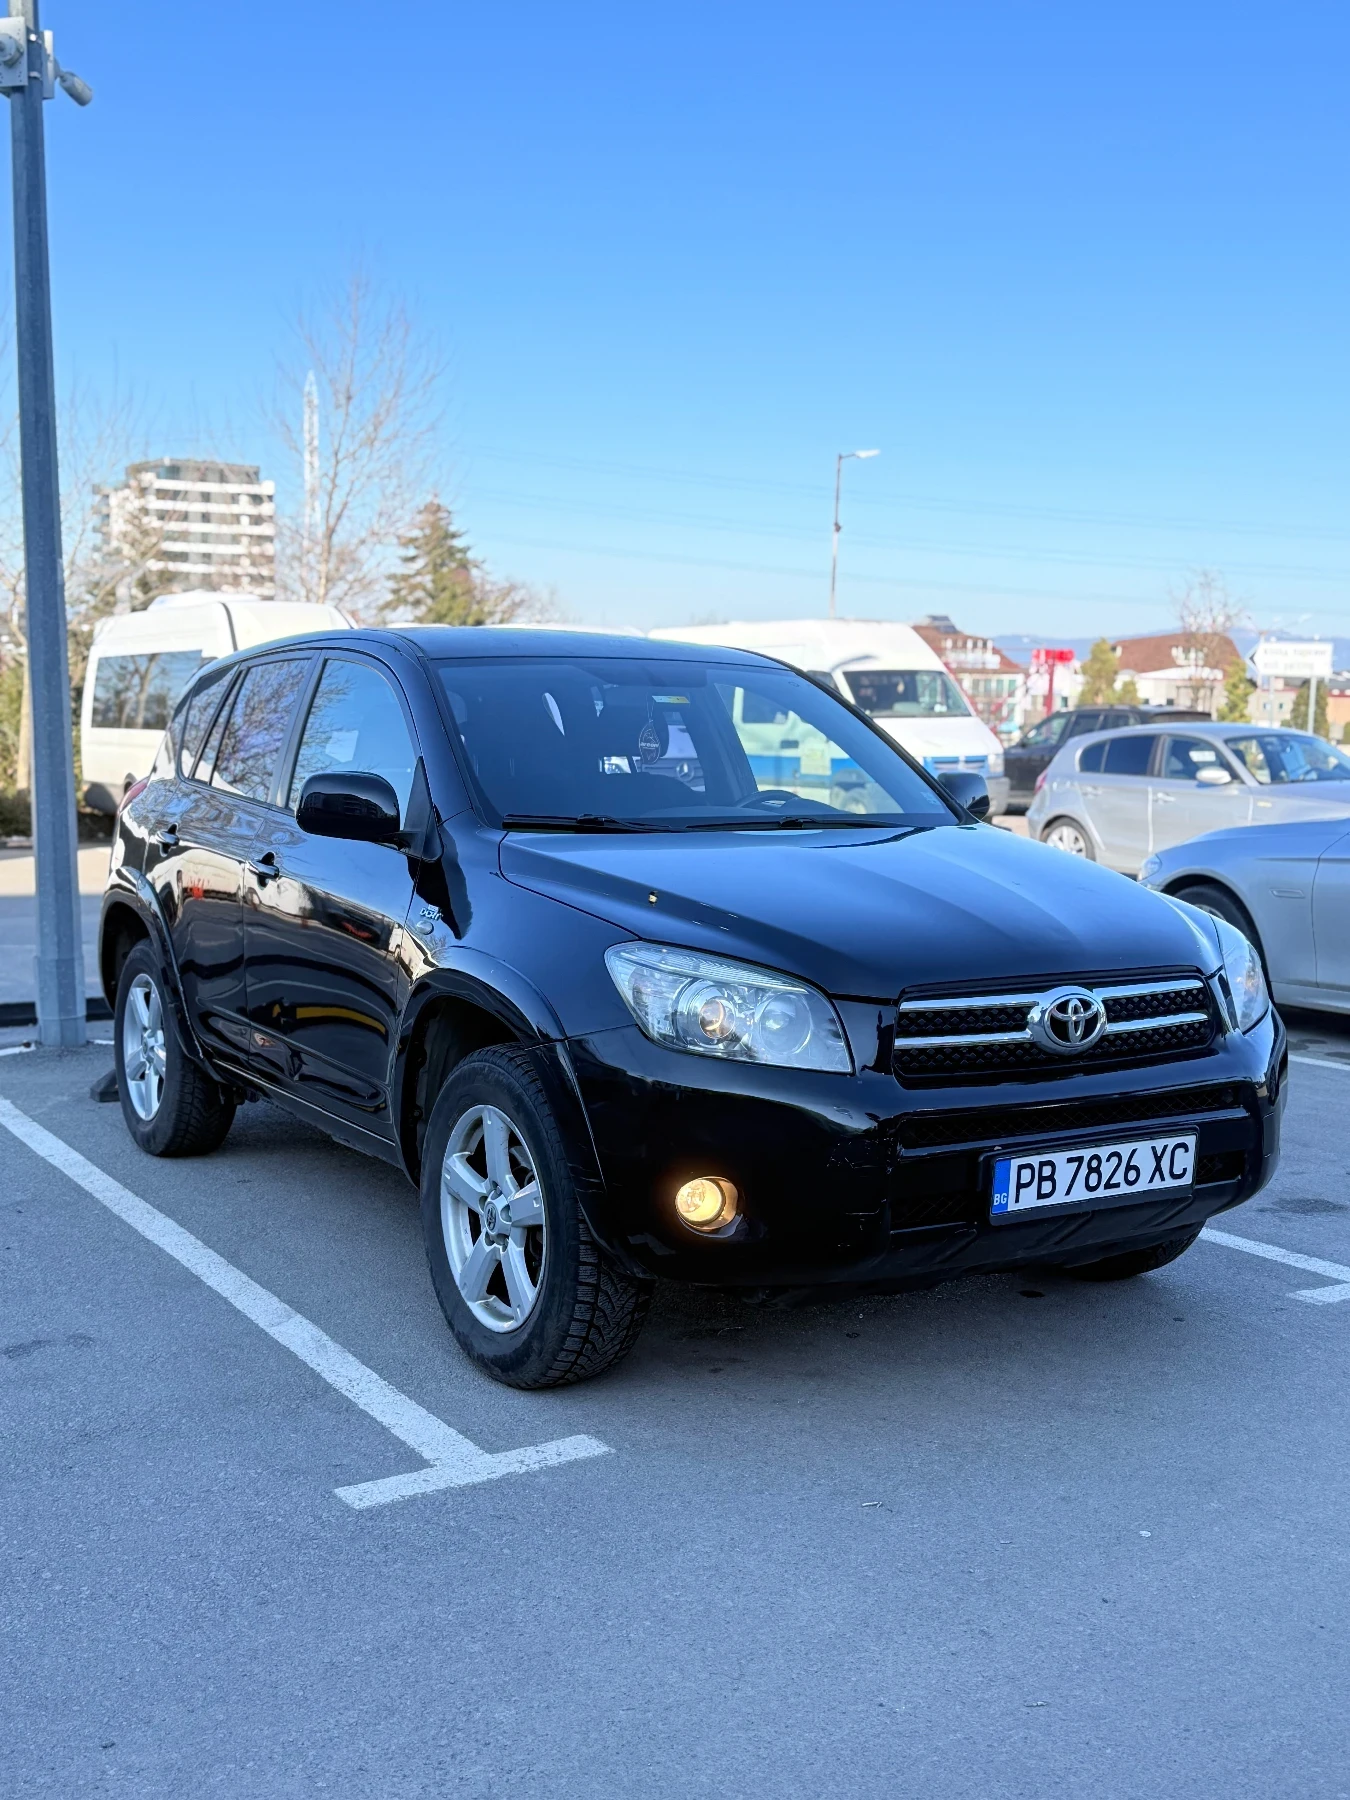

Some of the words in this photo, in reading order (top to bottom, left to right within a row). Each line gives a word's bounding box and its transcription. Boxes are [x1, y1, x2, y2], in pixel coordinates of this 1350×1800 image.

[1014, 1159, 1057, 1204] PB
[1064, 1148, 1141, 1196] 7826
[1147, 1141, 1190, 1184] XC
[993, 1192, 1008, 1206] BG
